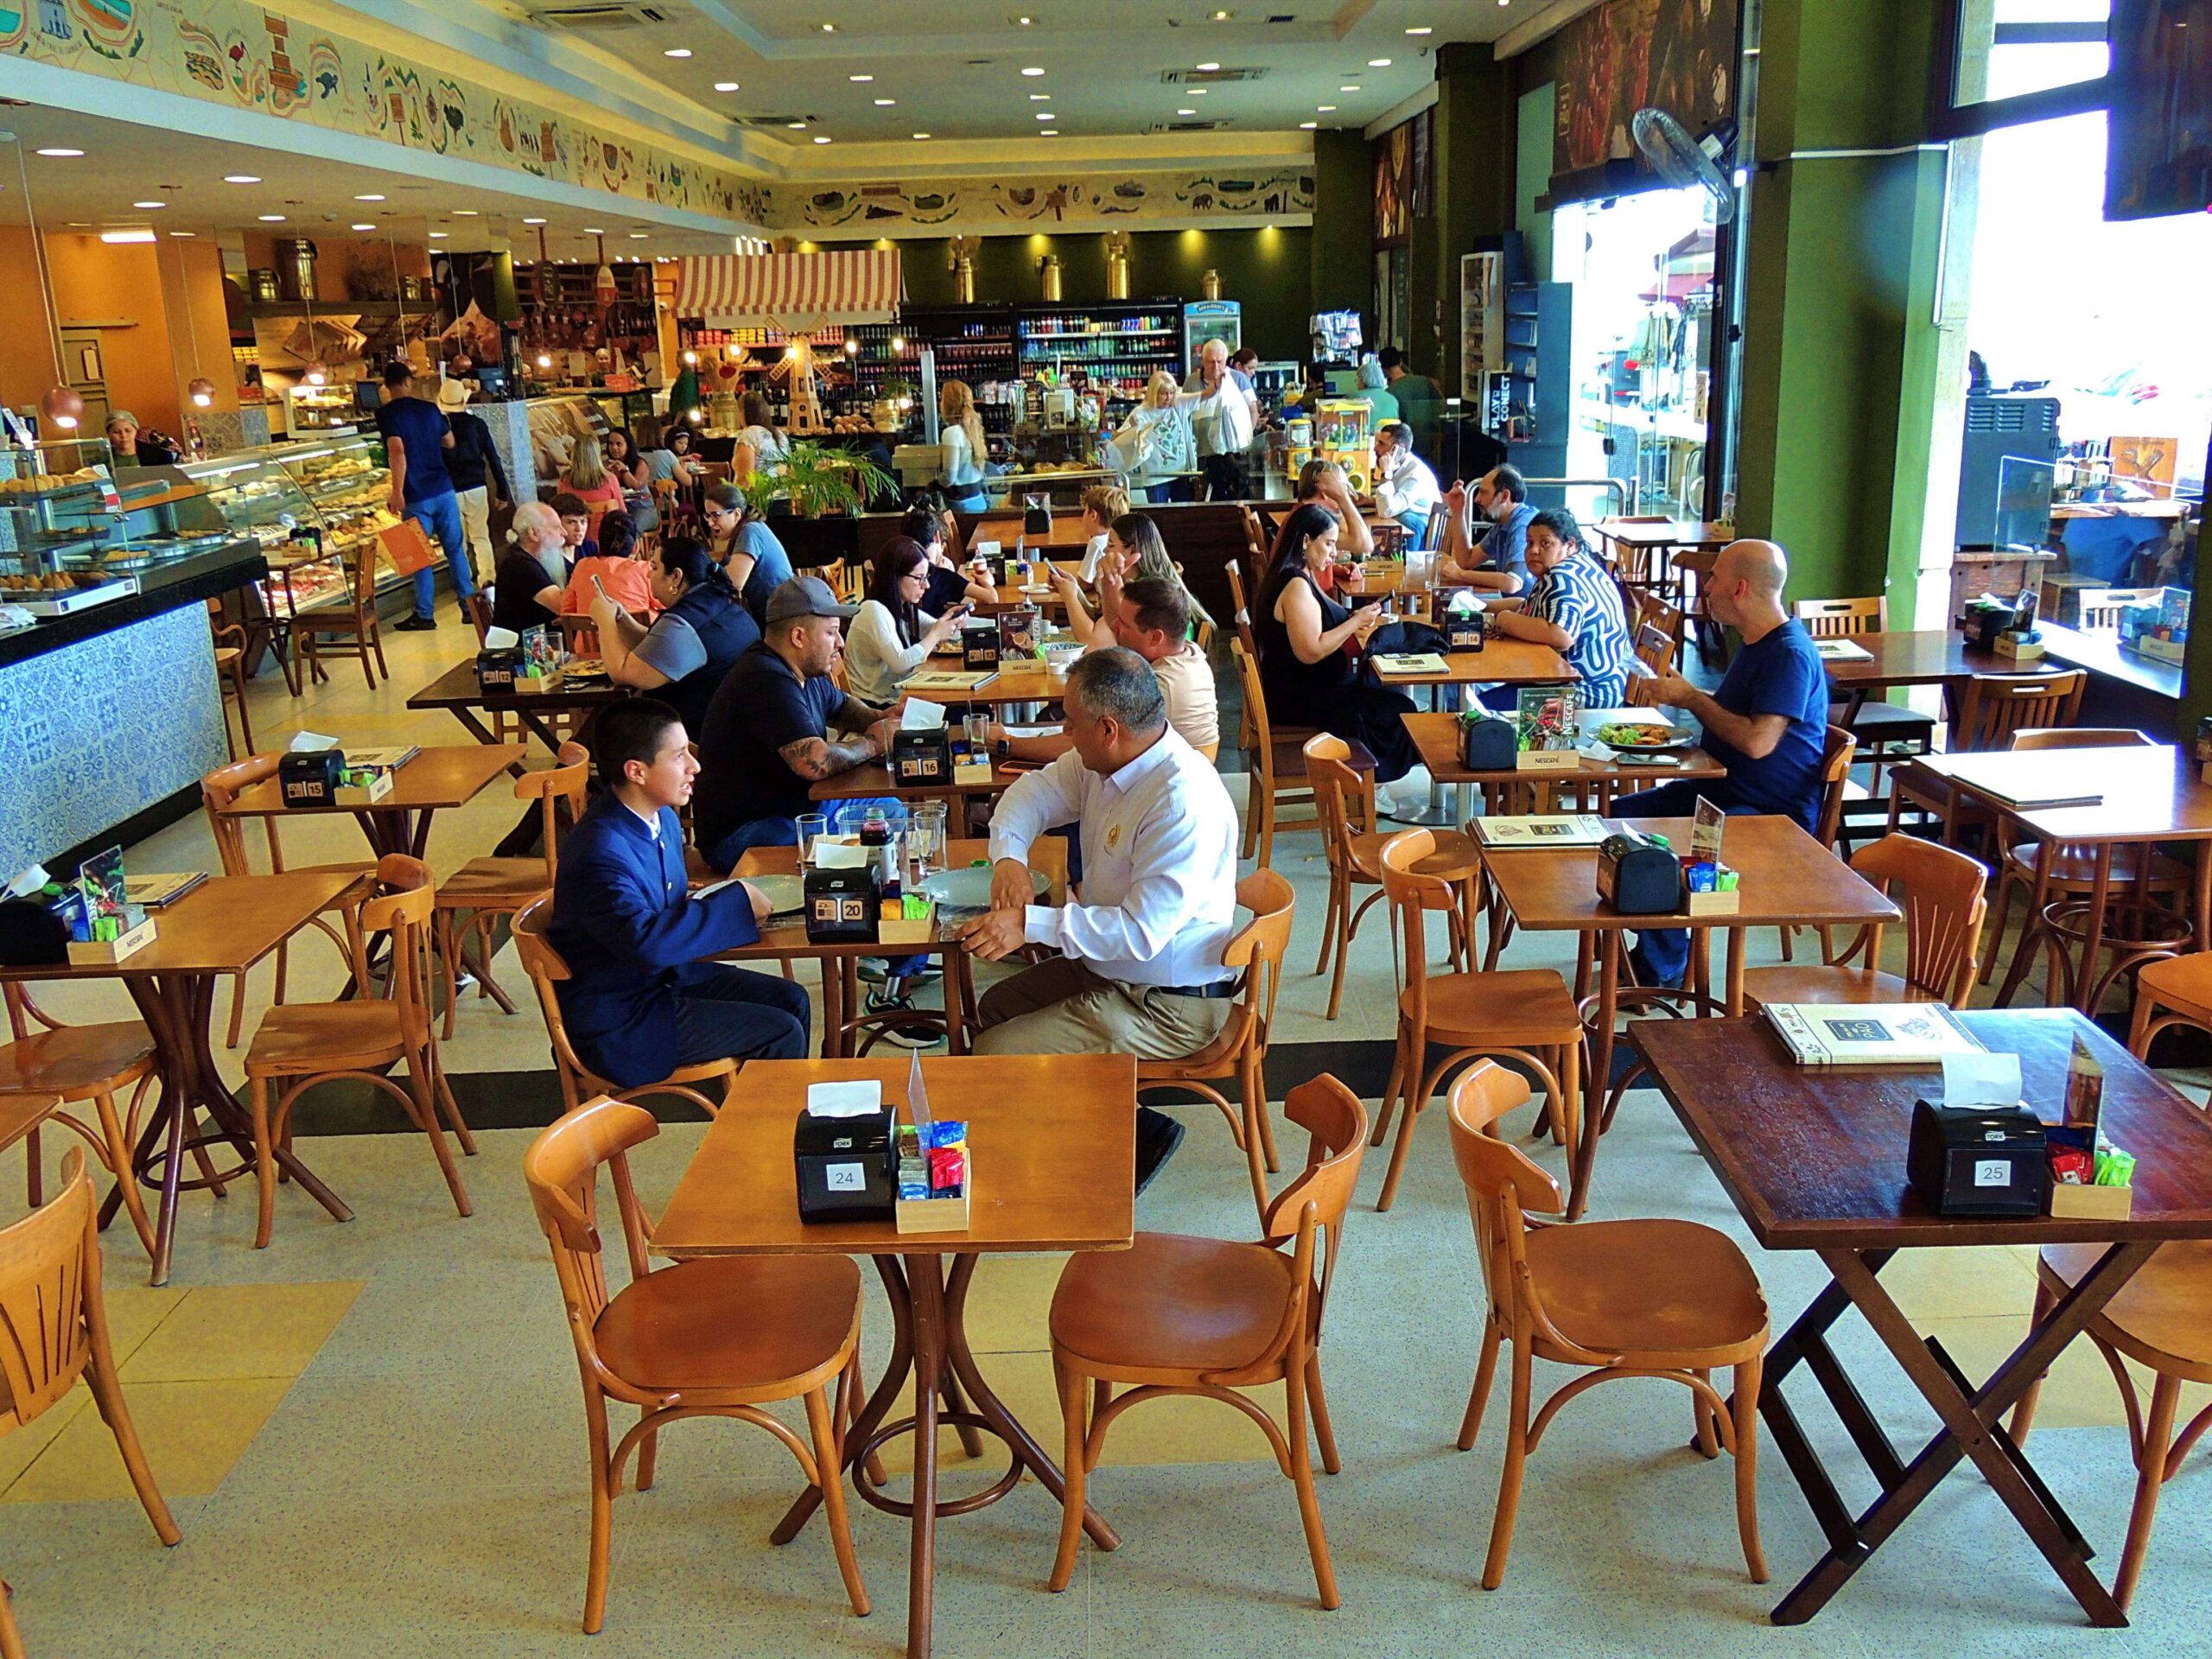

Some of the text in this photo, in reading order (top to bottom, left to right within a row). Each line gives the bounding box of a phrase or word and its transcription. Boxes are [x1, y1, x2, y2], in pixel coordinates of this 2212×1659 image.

[925, 763, 936, 772] 16
[309, 785, 321, 794] 15
[845, 905, 861, 916] 20
[1983, 1166, 2004, 1179] 25
[836, 1172, 854, 1185] 24
